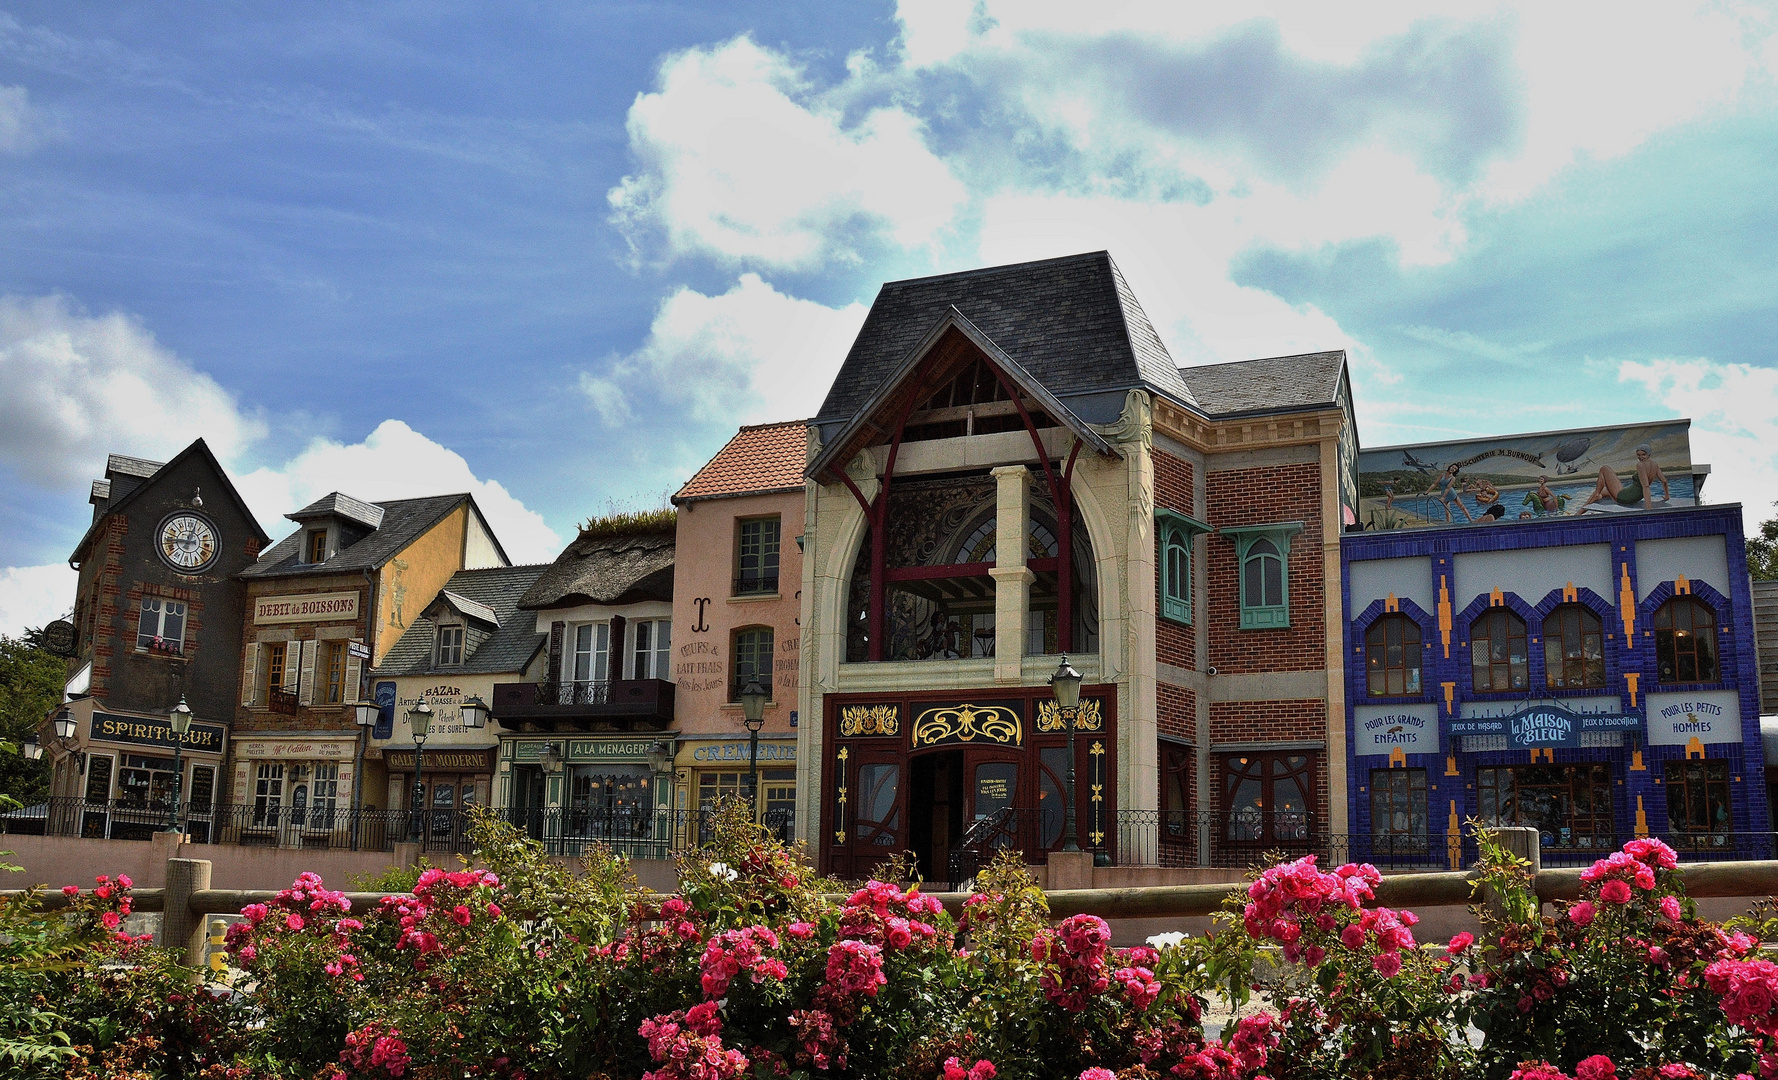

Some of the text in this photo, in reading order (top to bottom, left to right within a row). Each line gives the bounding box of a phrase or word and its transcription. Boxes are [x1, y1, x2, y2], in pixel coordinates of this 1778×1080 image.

[1458, 450, 1496, 468] BISCUITERIE
[259, 598, 354, 617] DEBIT de BOISSONS
[711, 645, 719, 656] &
[676, 661, 723, 674] LAIT FRAIS
[425, 685, 461, 697] BAZAR
[1660, 702, 1723, 719] POUR LES PETITS
[1364, 714, 1425, 731] POUR LES GRANDS
[1452, 722, 1503, 732] JEUX DE HASARD
[1520, 712, 1572, 735] MAISON
[1582, 718, 1598, 728] JEUX
[1672, 721, 1712, 733] HOMMES
[1374, 732, 1417, 743] ENFANTS
[1523, 727, 1567, 746] BLEUE
[574, 743, 582, 754] A
[584, 743, 596, 754] LA
[693, 743, 798, 761] CREMERIE
[390, 752, 486, 768] GALEIE MODERNE
